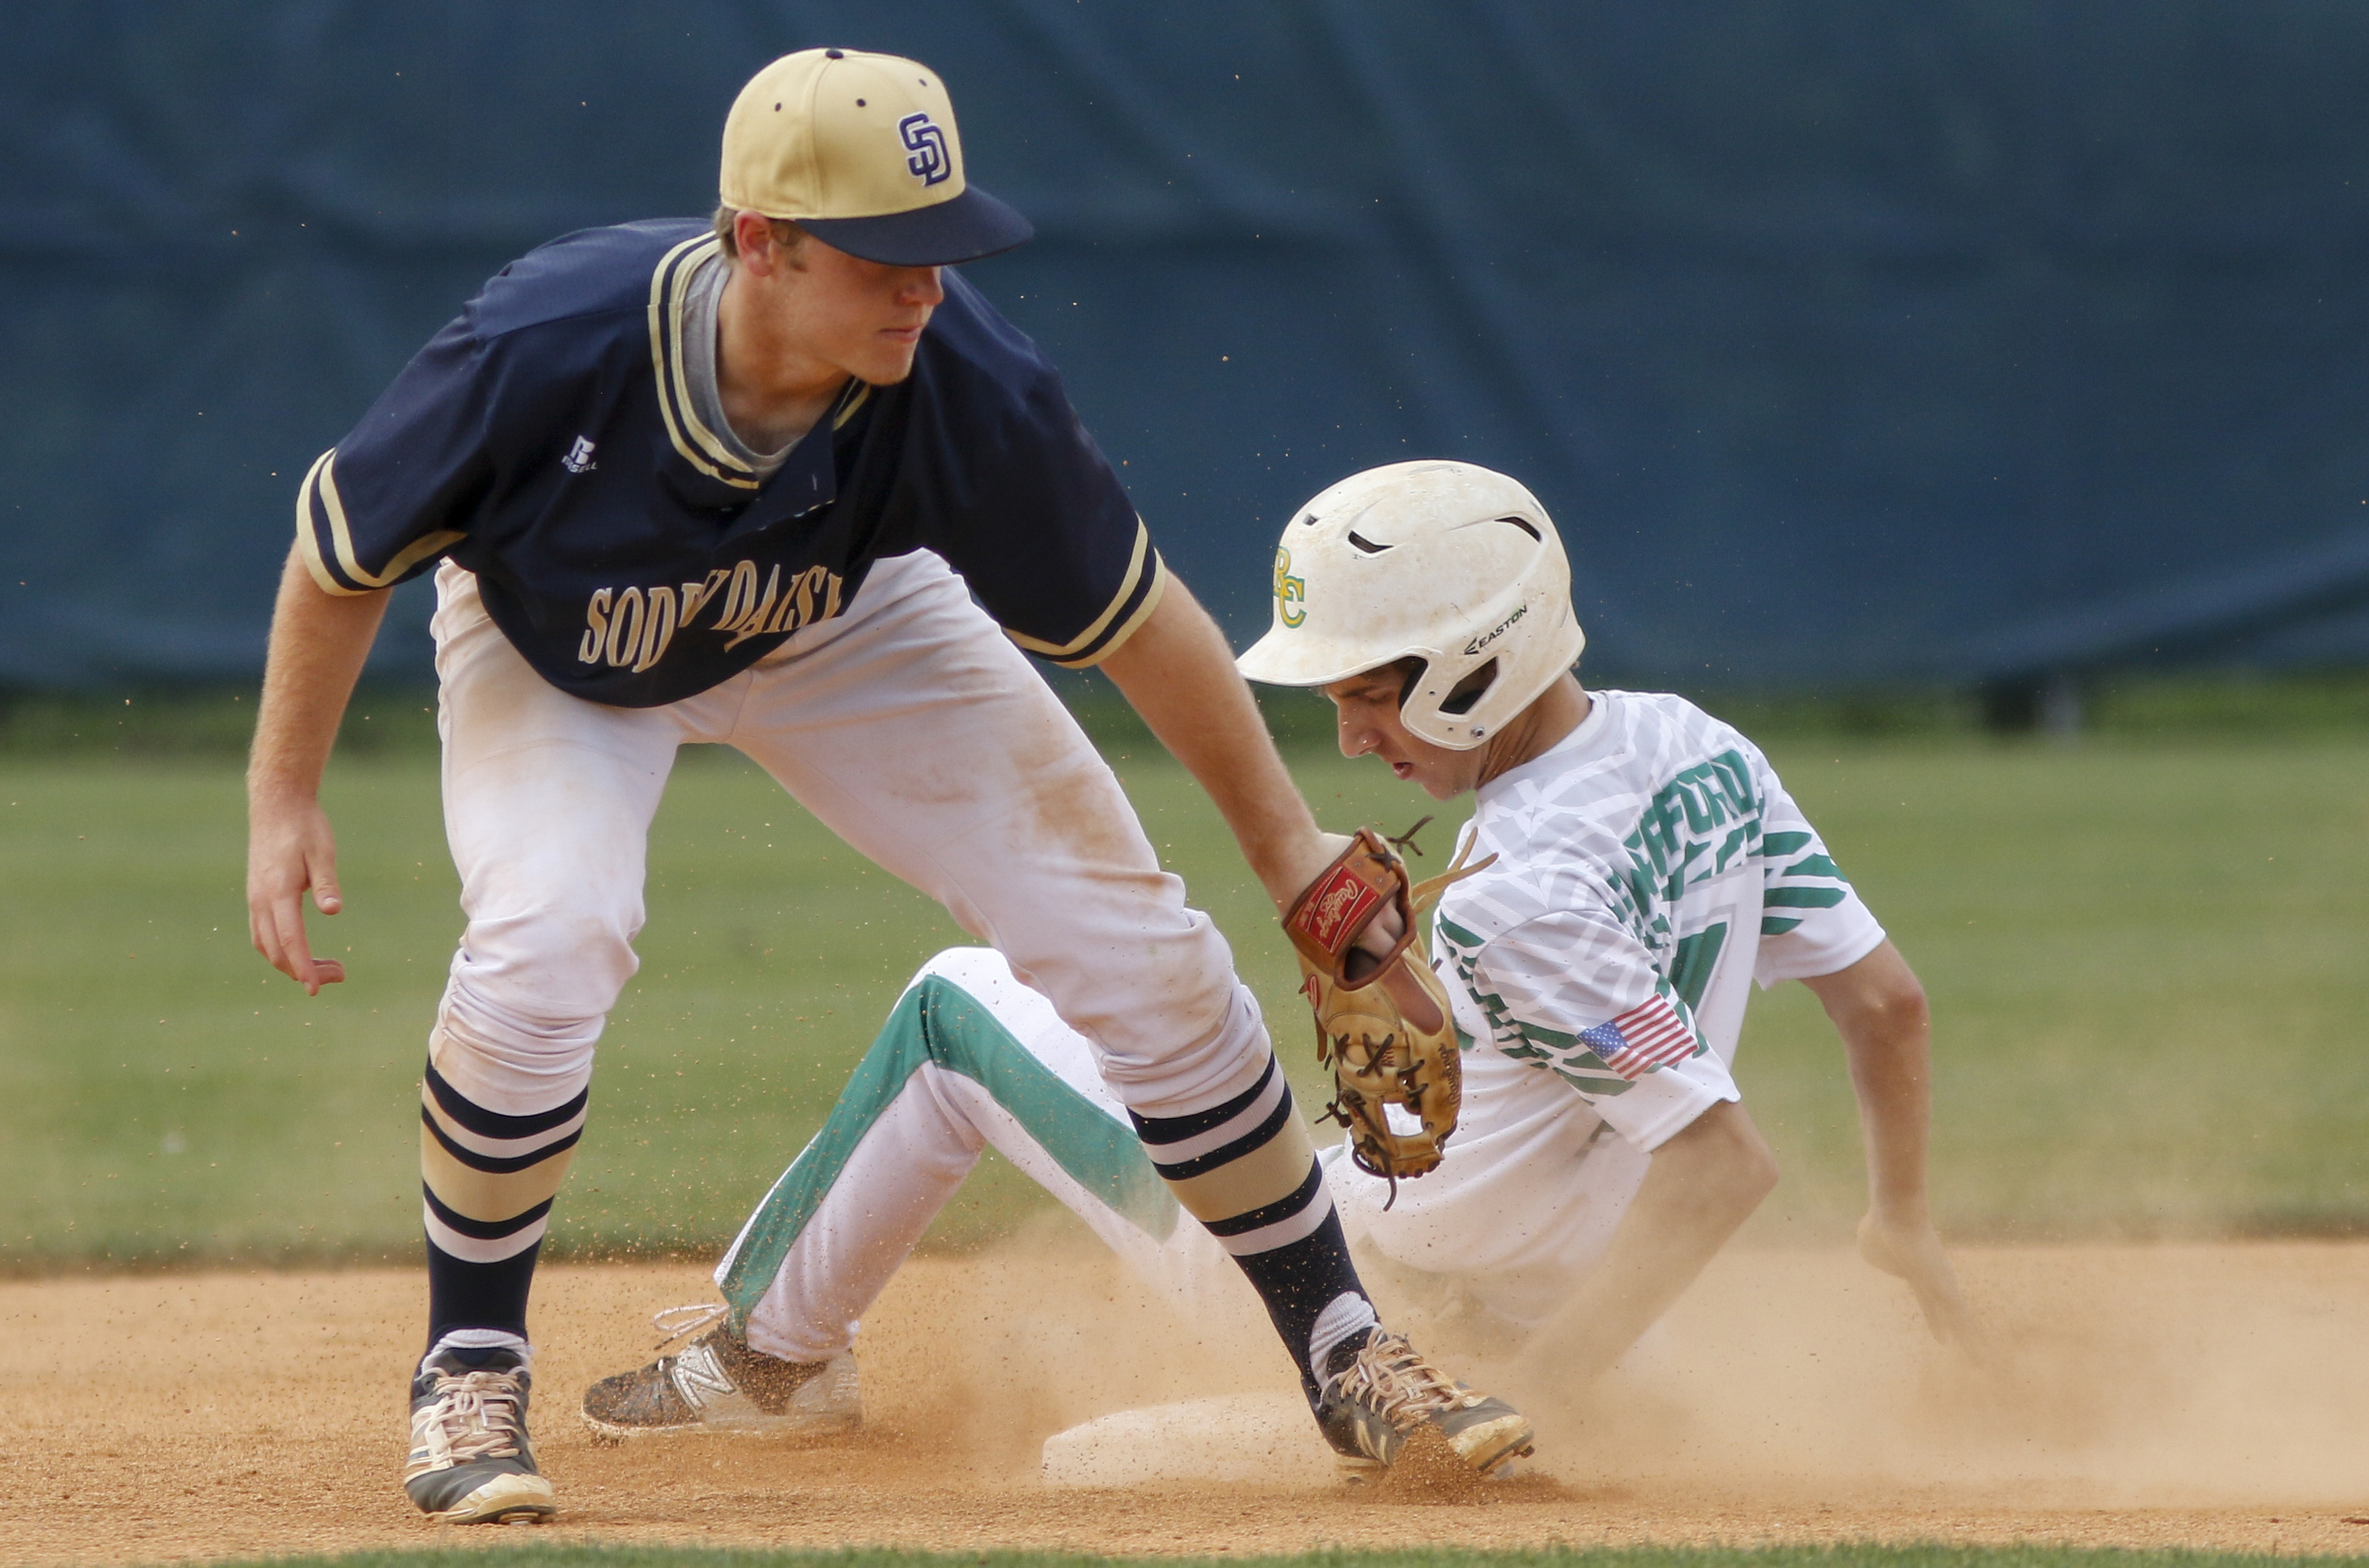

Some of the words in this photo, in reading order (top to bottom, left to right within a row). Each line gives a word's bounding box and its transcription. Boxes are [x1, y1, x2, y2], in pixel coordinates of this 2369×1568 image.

[897, 111, 952, 187] SD
[1478, 603, 1528, 648] EASTON
[1316, 878, 1359, 939] Rawlings
